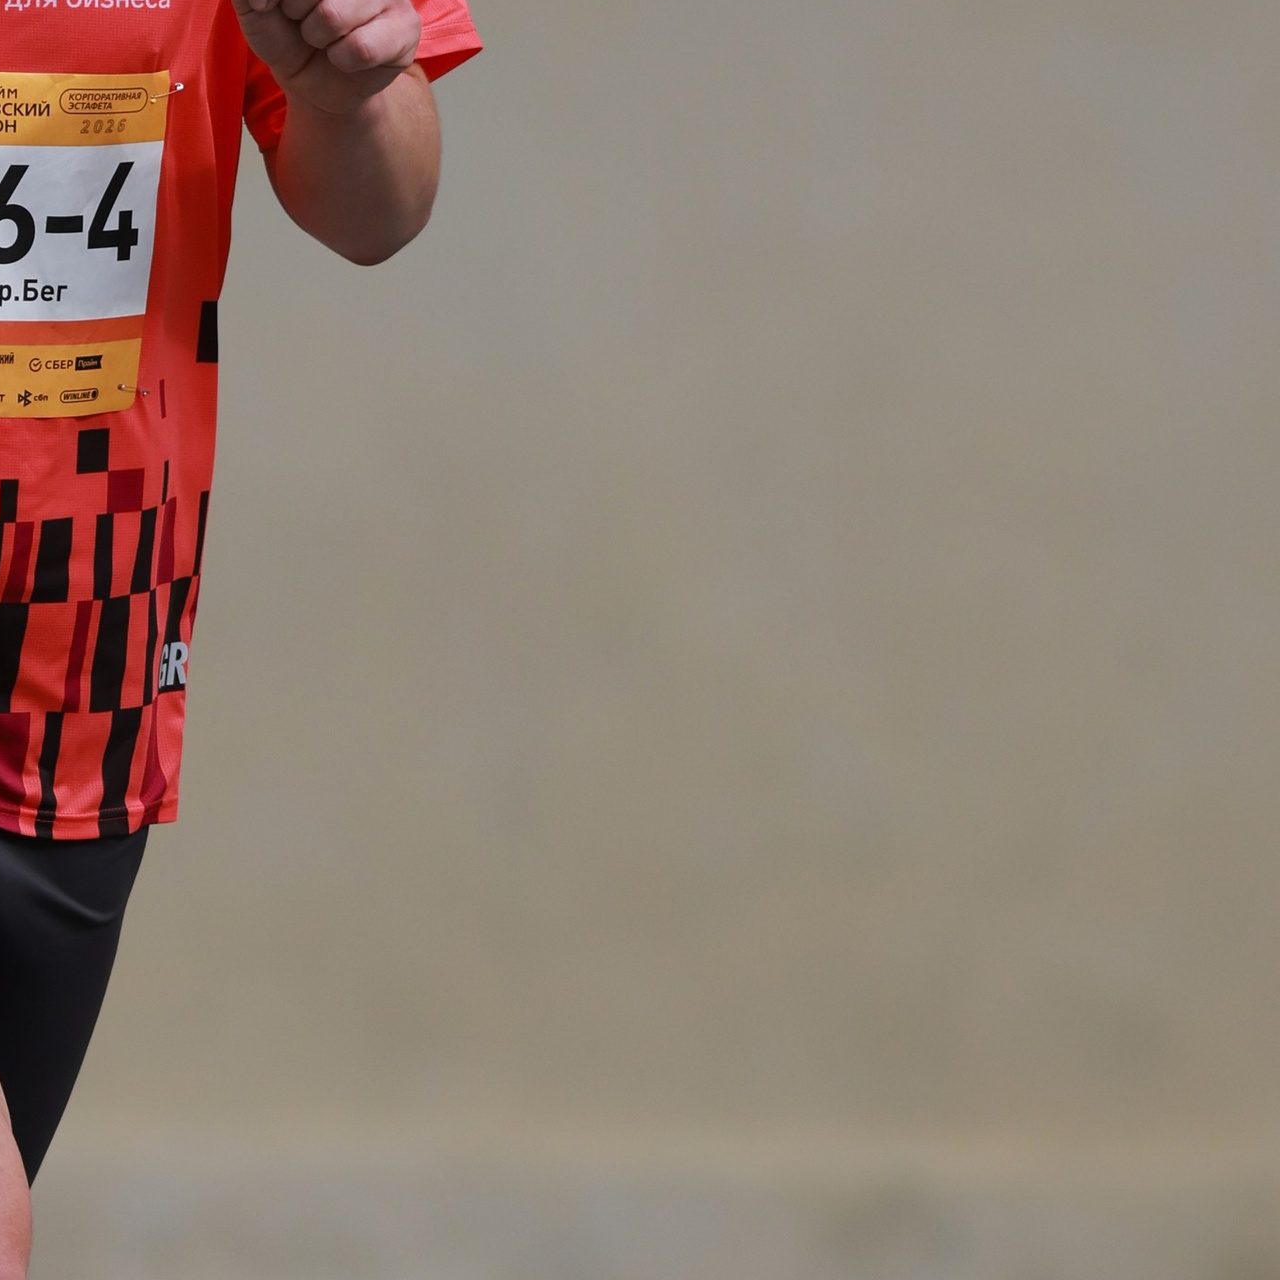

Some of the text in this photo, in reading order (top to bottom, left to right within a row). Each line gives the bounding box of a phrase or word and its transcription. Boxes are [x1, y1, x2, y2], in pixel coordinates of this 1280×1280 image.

[68, 91, 142, 101] КОРПОРАТИВНАЯ
[68, 102, 113, 110] ЭСТАФЕТА
[45, 359, 73, 370] СБЕР
[63, 391, 91, 401] WINLINE
